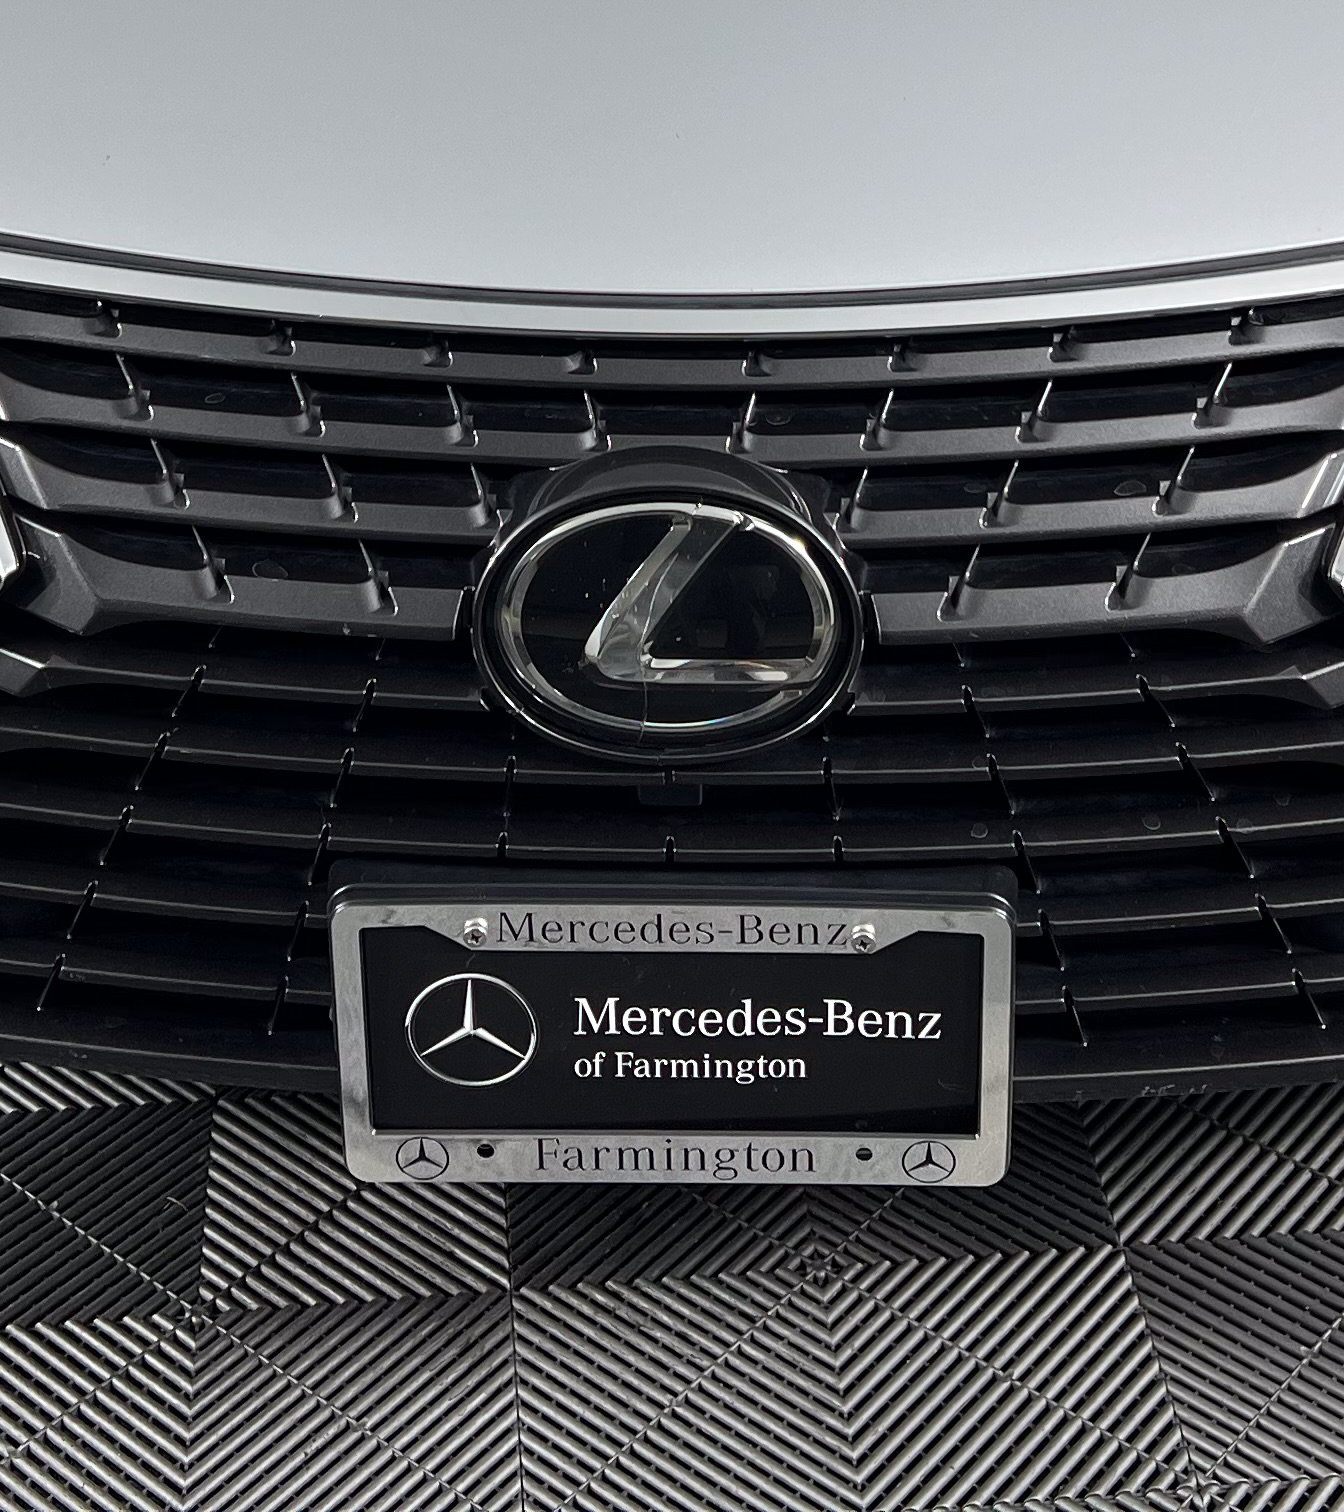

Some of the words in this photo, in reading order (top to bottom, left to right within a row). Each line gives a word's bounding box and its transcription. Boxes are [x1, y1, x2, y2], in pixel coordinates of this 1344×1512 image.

[497, 912, 848, 947] Mercedes-Benz
[573, 998, 942, 1040] Mercedes-Benz
[574, 1051, 606, 1078] of
[614, 1052, 807, 1085] Farmington
[535, 1138, 817, 1180] Farmington
